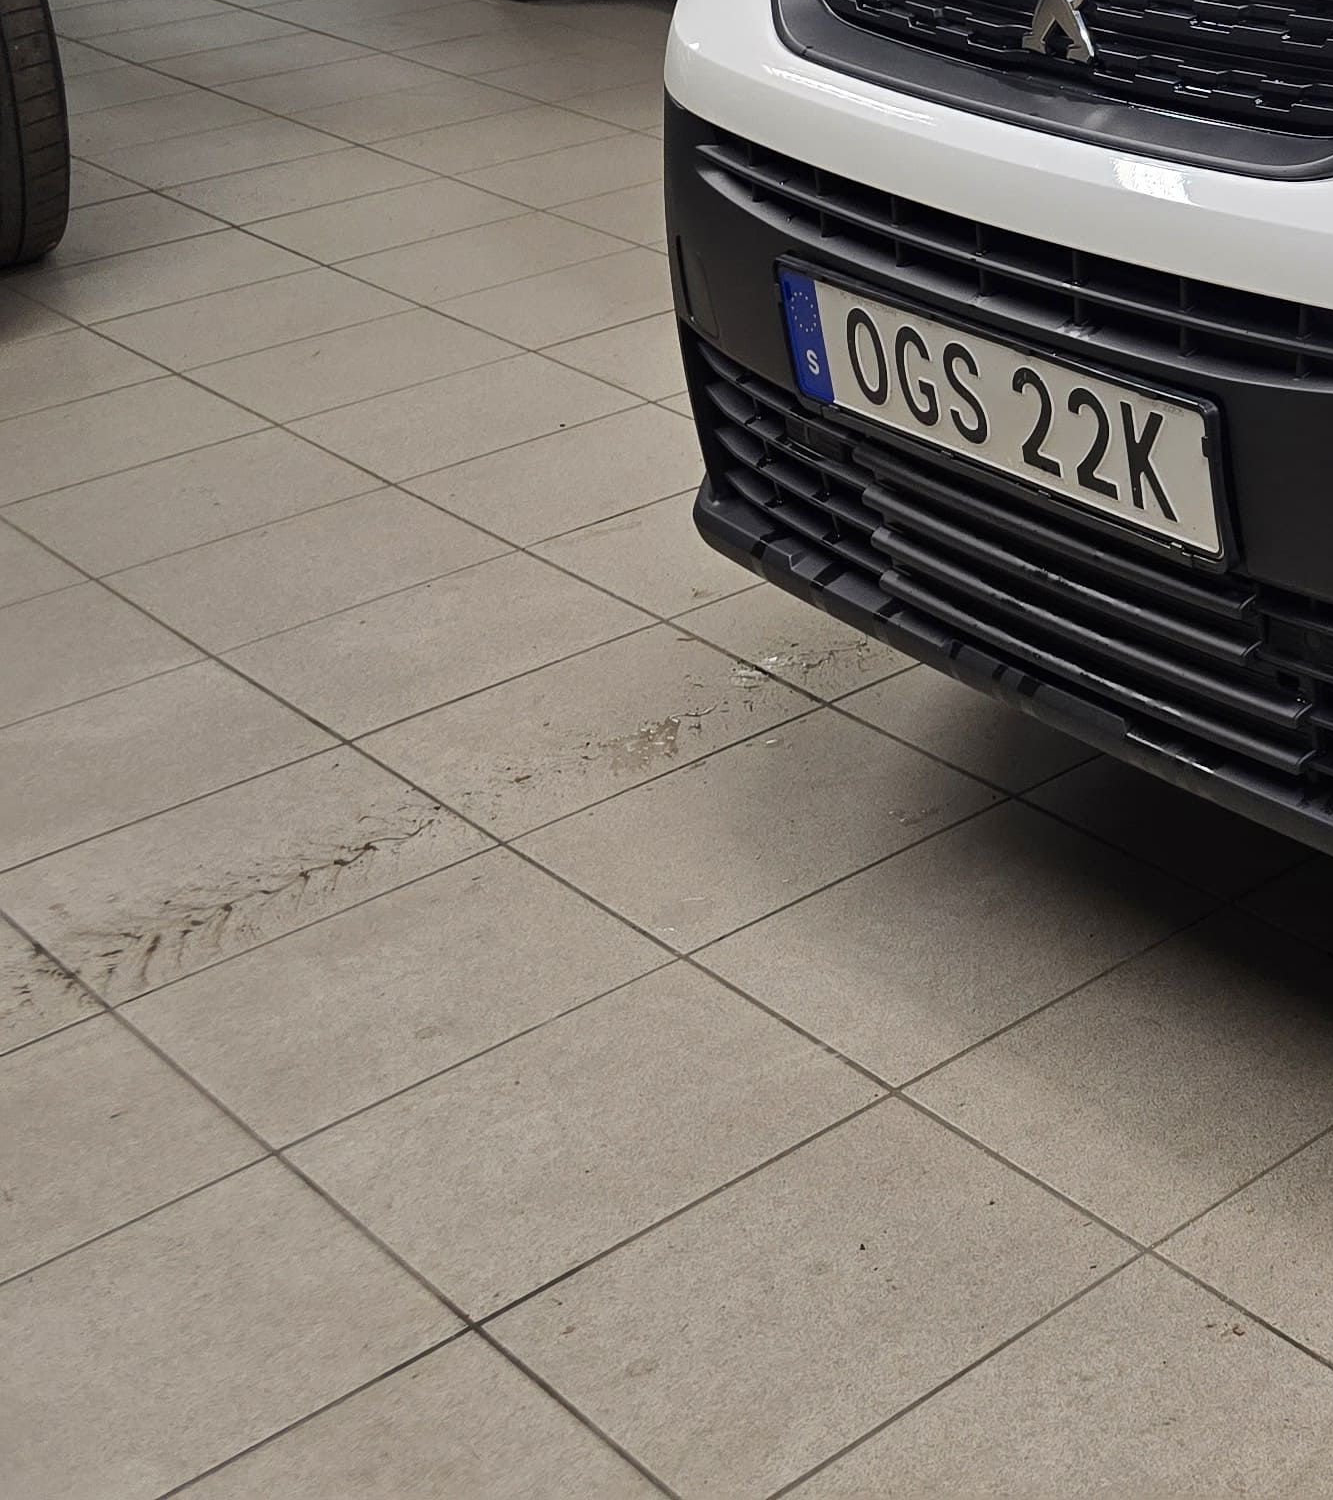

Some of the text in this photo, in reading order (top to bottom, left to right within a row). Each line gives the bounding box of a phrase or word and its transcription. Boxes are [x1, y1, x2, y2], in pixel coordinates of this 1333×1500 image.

[805, 348, 820, 376] S
[845, 306, 1179, 524] OGS 22K
